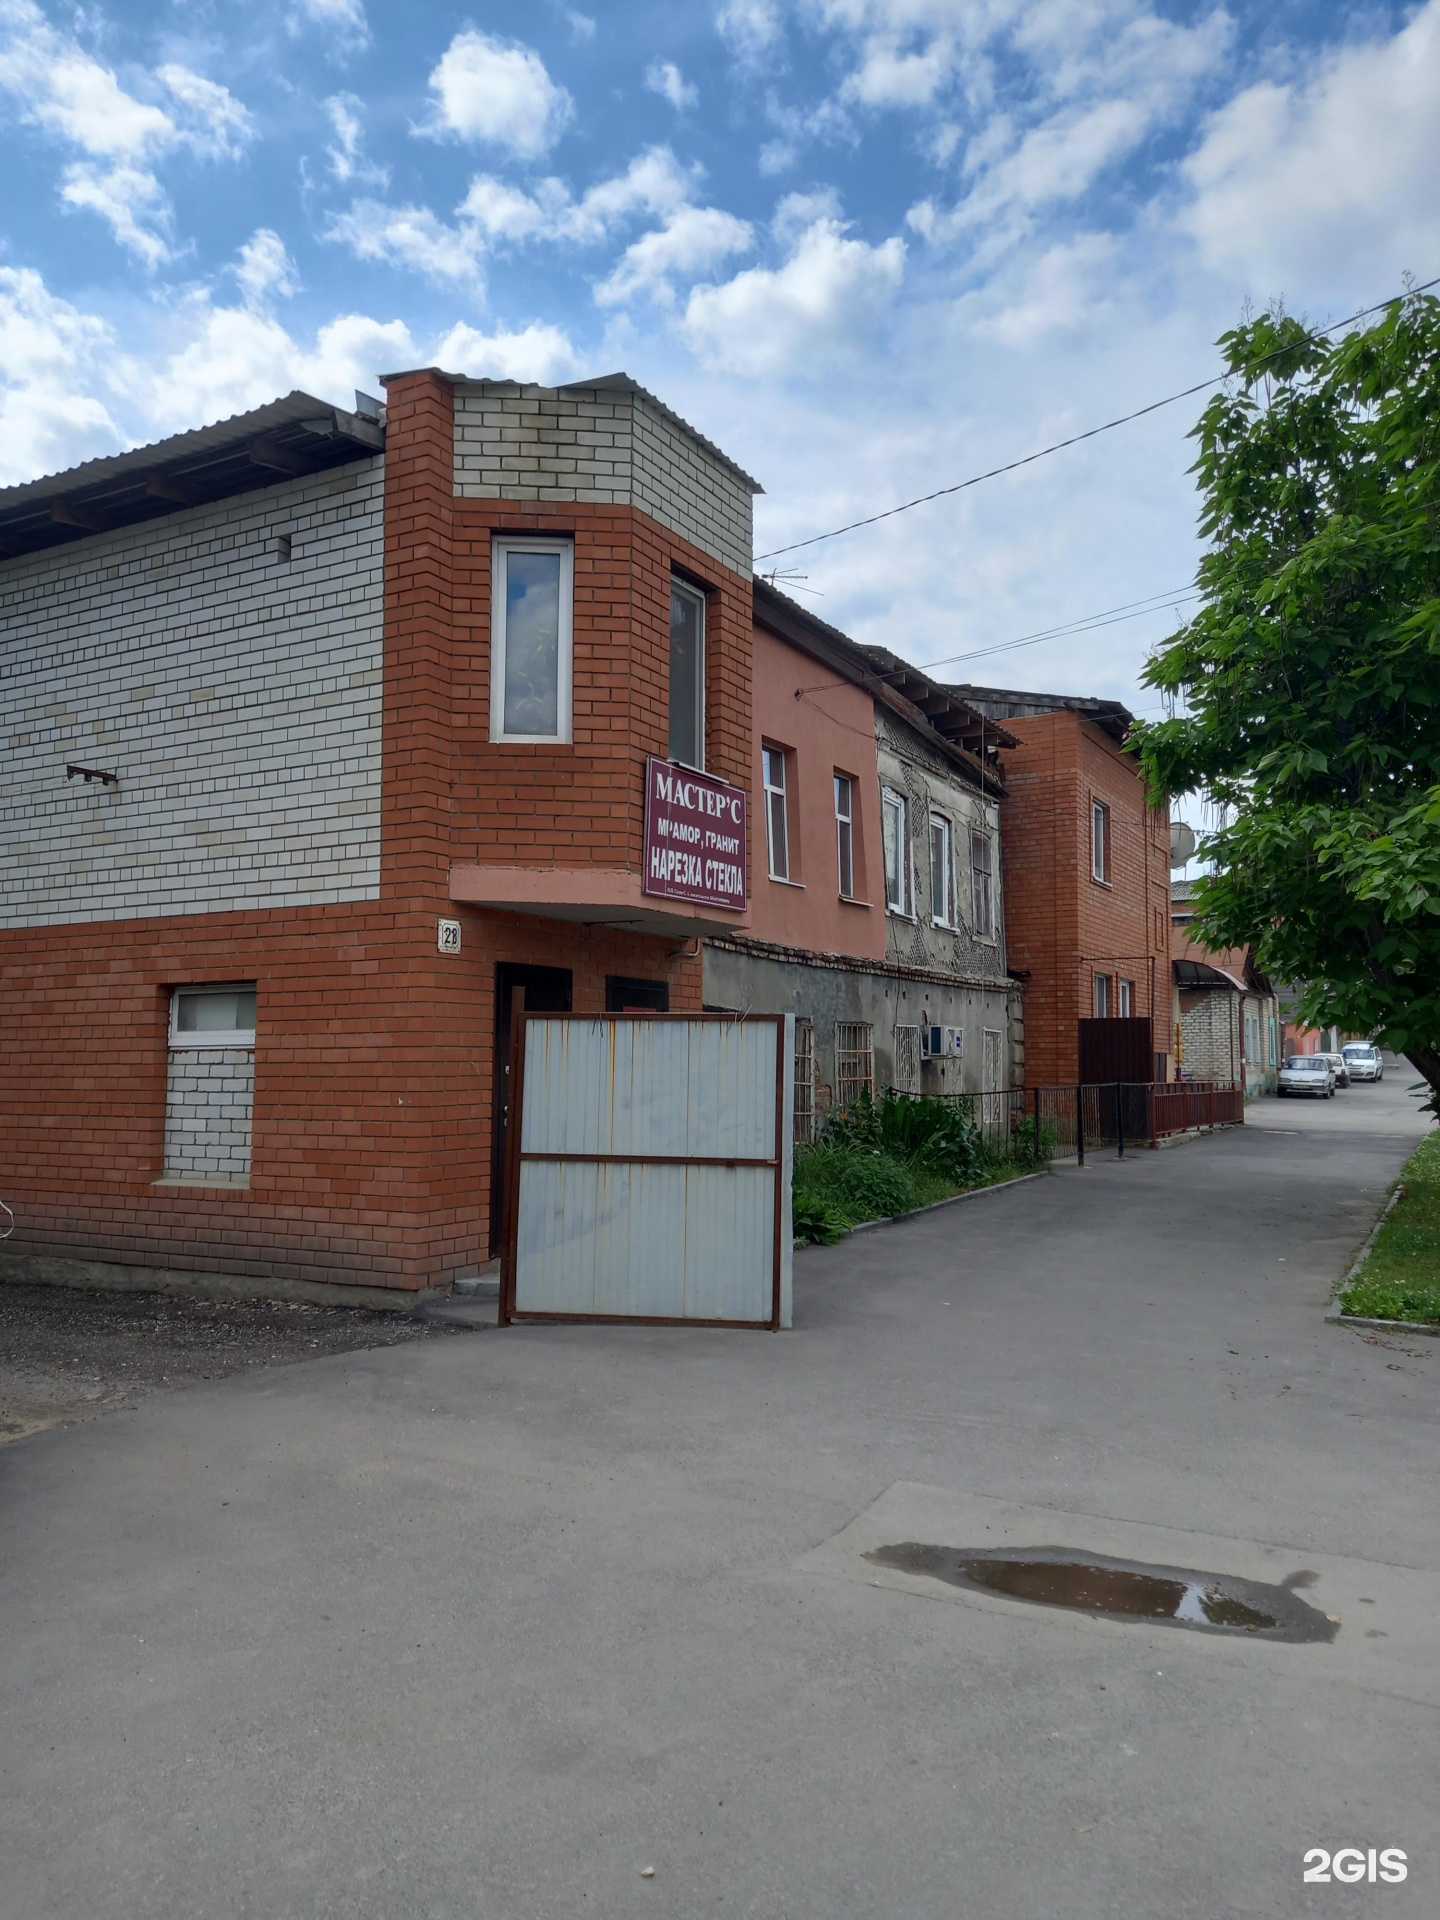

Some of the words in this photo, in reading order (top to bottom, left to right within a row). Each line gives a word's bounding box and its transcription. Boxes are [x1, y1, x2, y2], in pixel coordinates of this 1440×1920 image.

[705, 830, 740, 856] ГРАНИТ
[651, 846, 703, 888] НАРЕЗКА
[705, 859, 744, 897] СТЕКЛА
